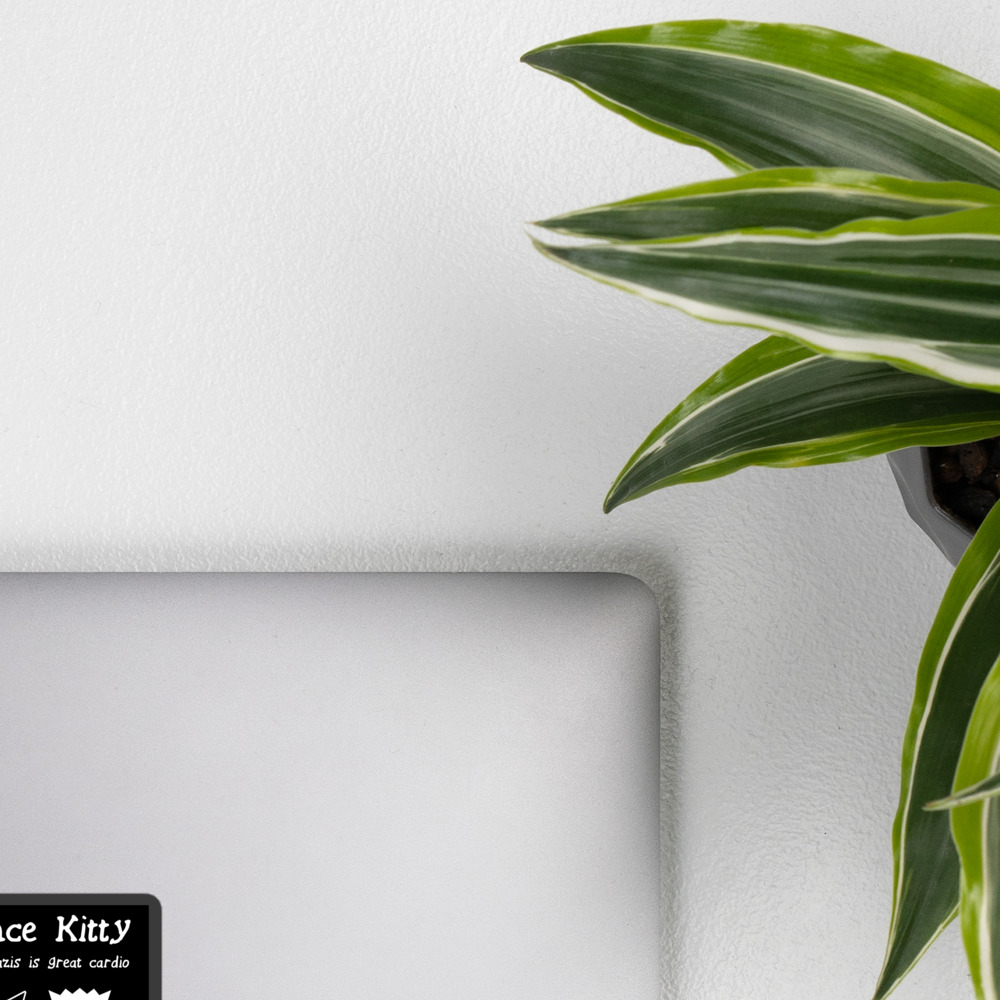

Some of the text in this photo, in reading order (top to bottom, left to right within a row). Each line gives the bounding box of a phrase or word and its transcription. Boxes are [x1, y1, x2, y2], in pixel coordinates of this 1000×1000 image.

[54, 914, 132, 945] Kitty
[28, 955, 41, 969] is
[47, 956, 82, 970] great
[88, 954, 130, 969] cardio
